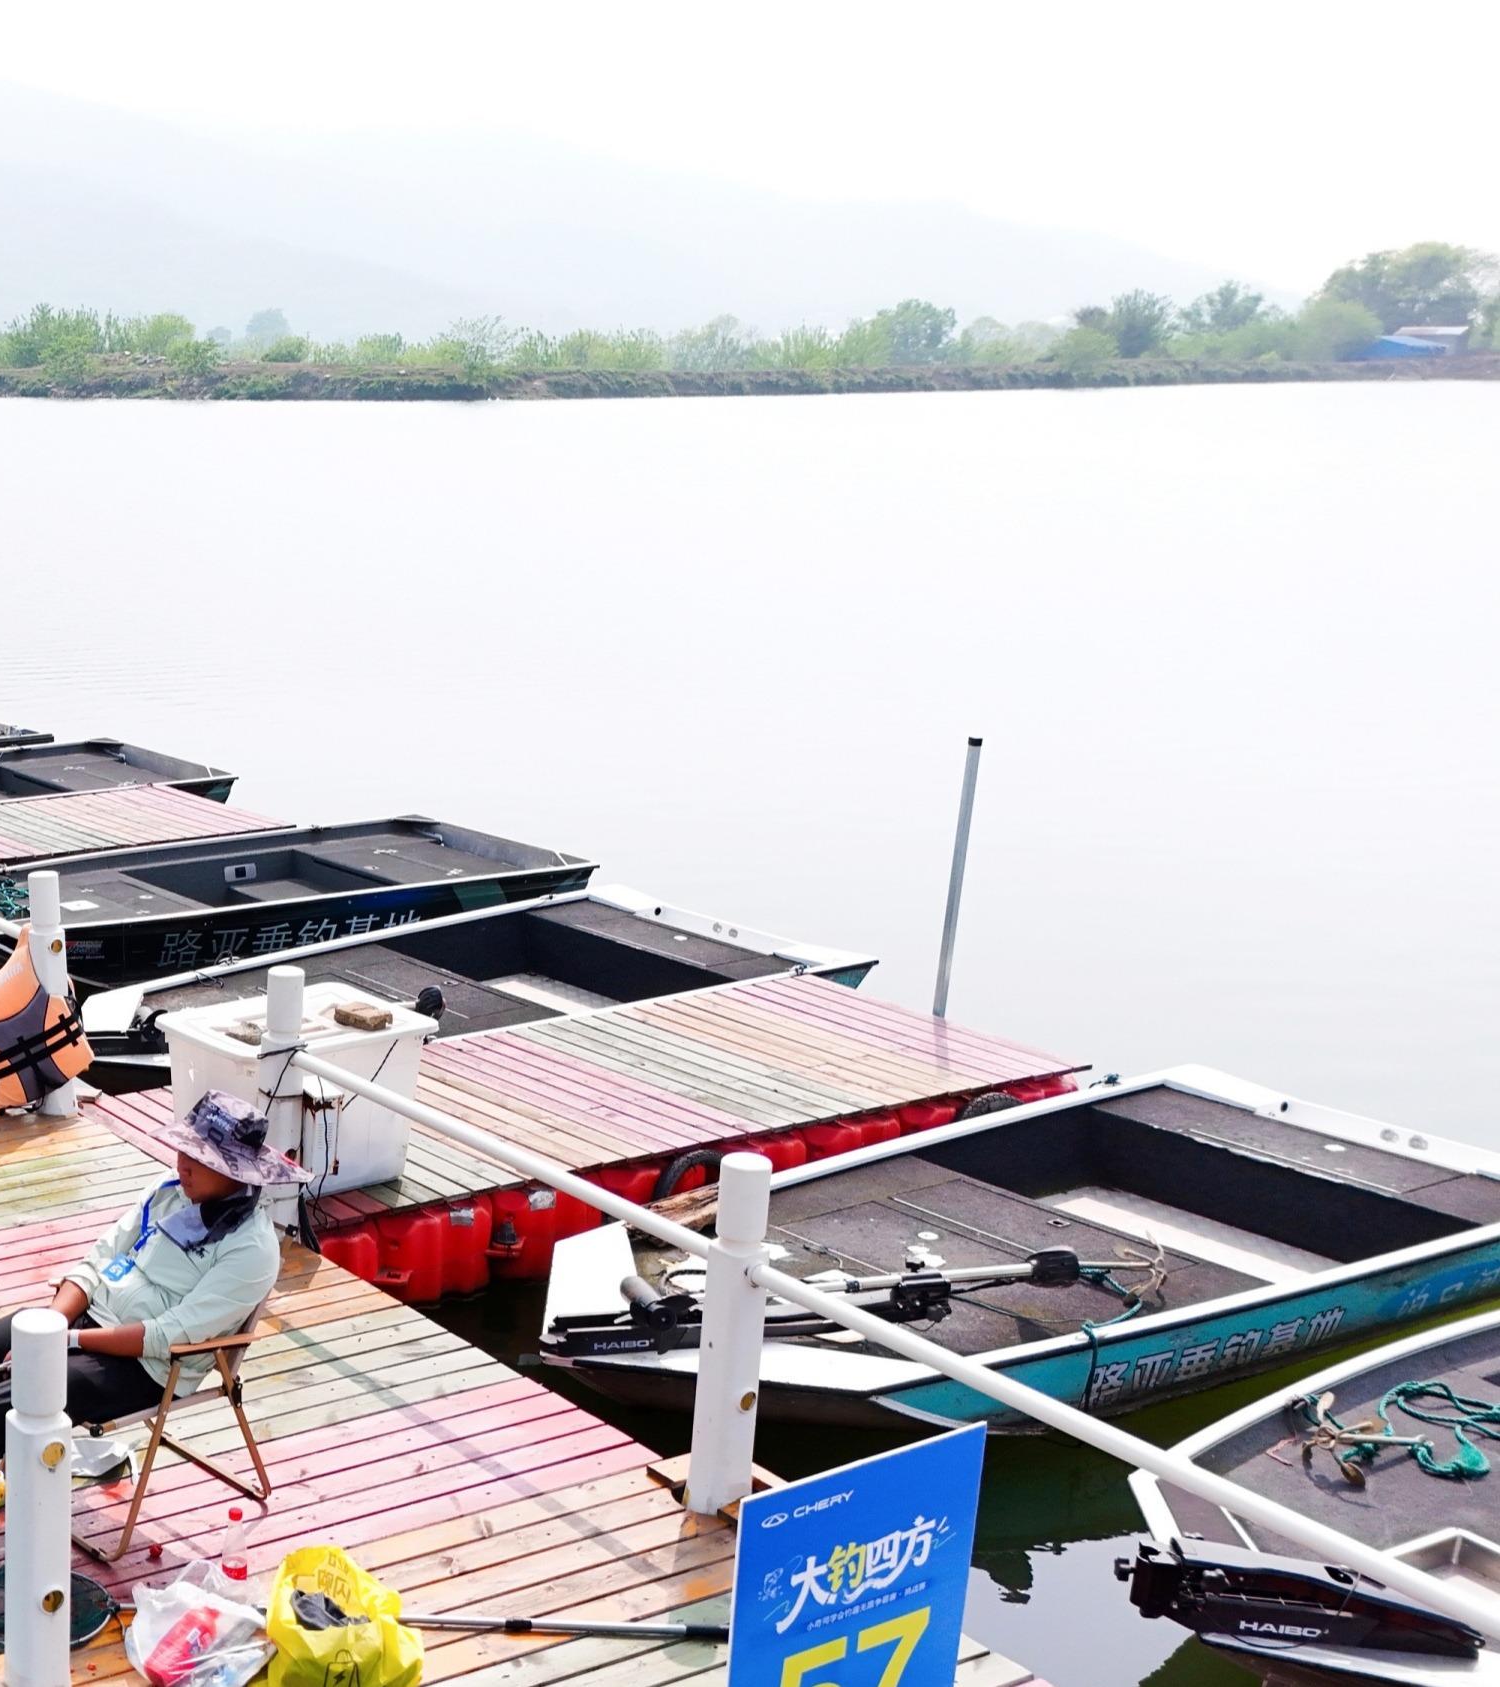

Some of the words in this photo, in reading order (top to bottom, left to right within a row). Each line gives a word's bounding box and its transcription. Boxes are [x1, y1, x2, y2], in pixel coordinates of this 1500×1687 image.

[593, 1339, 650, 1351] HAIBO
[793, 1490, 854, 1518] CHERY
[775, 1515, 936, 1634] 大钓四方
[1239, 1620, 1322, 1638] HAIBO
